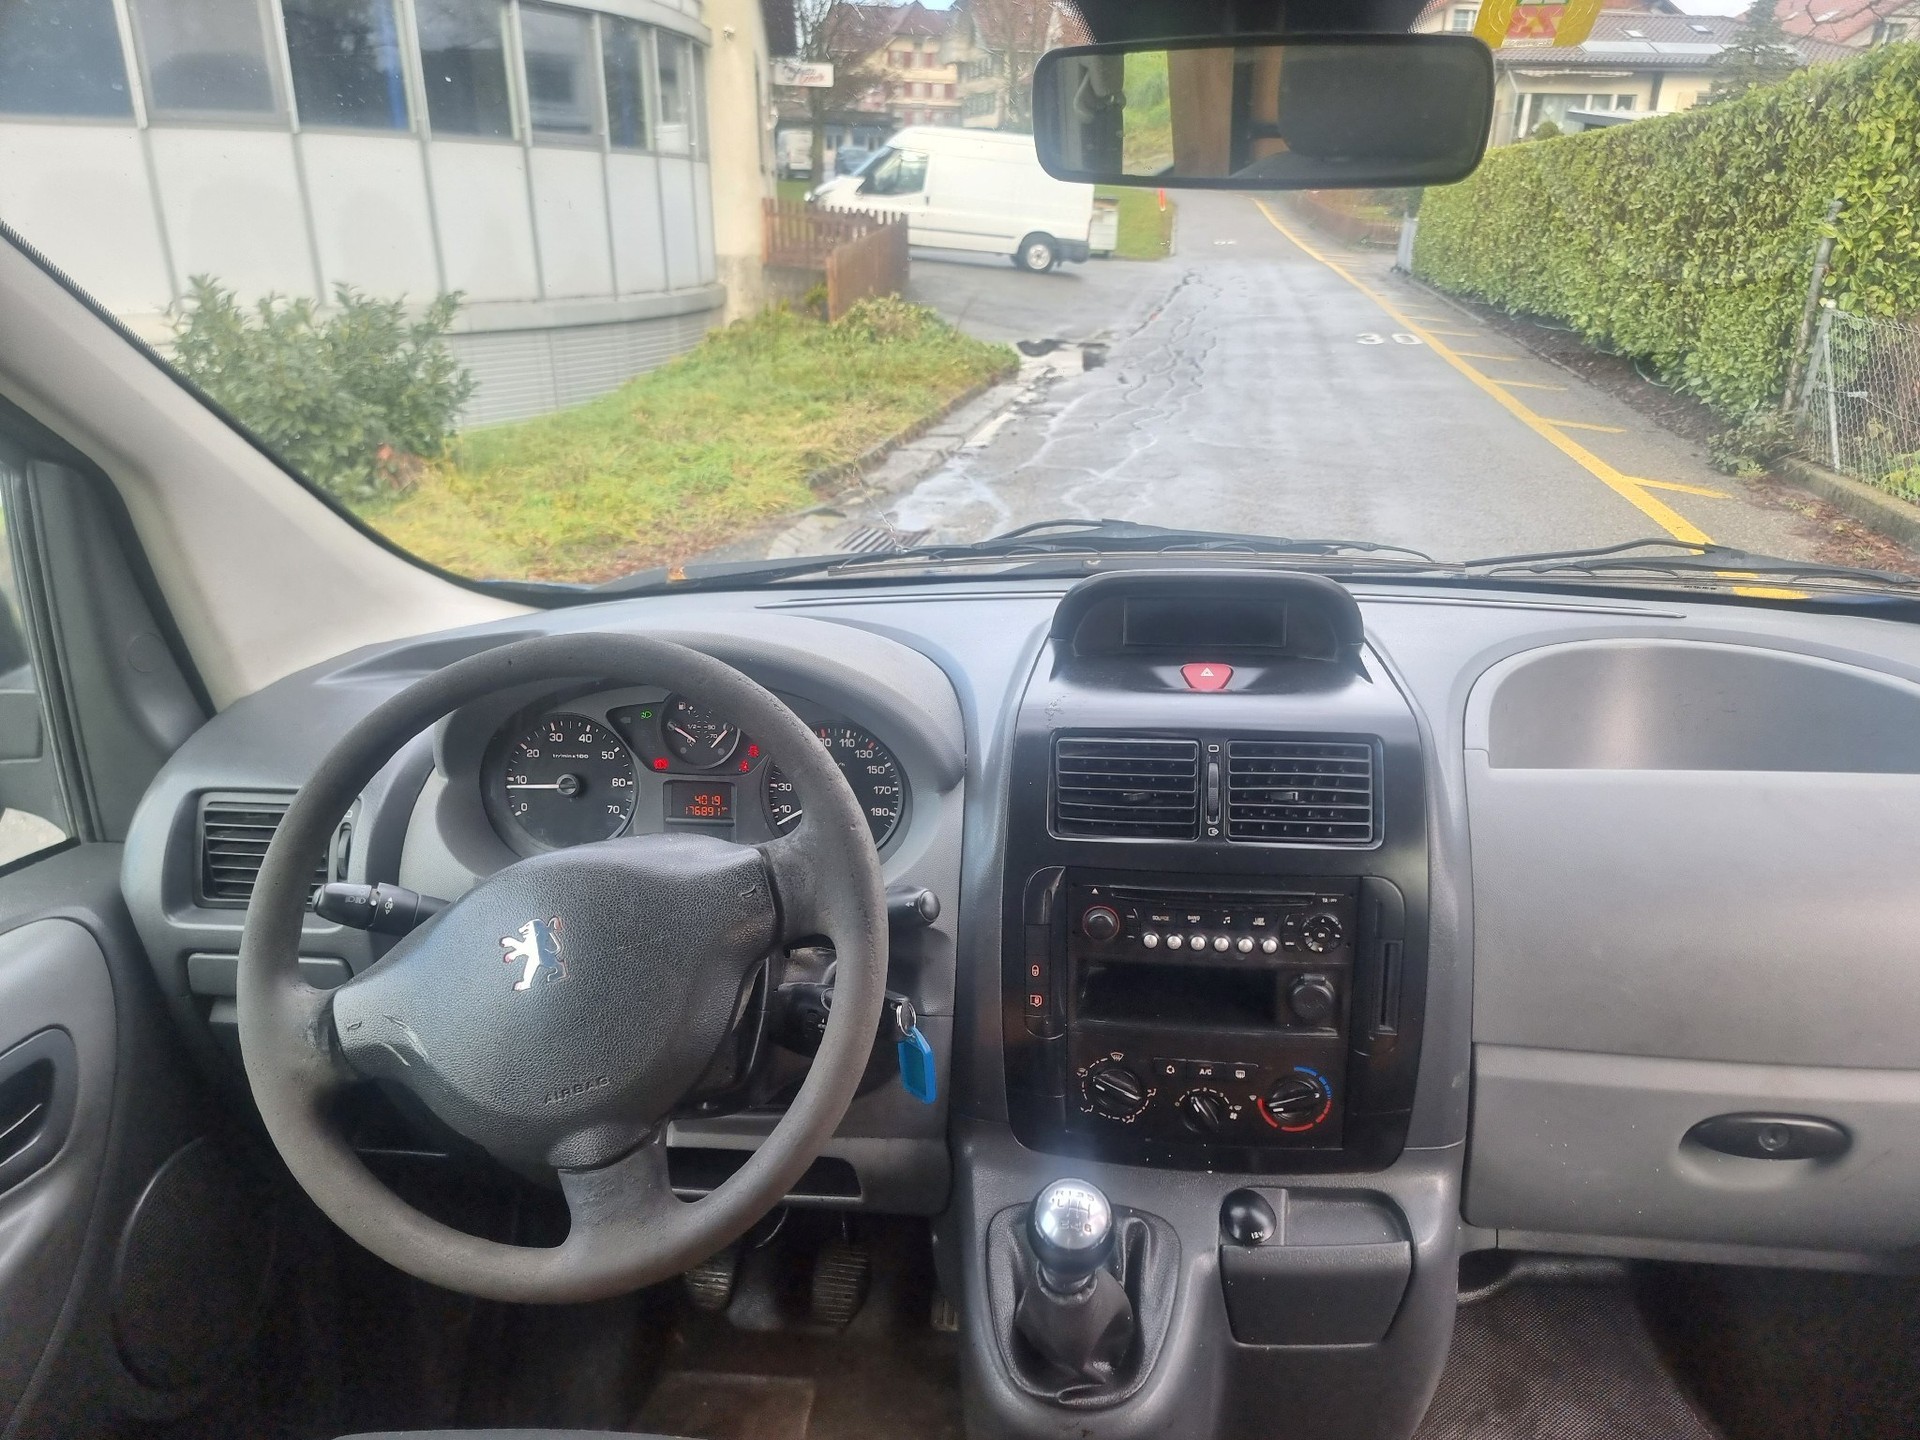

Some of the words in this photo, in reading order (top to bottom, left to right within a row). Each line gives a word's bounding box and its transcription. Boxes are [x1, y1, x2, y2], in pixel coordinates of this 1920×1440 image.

[1356, 332, 1423, 345] 30
[548, 732, 564, 743] 30
[578, 733, 593, 744] 40
[838, 739, 856, 748] 110
[526, 748, 540, 758] 20
[601, 750, 615, 760] 50
[854, 750, 873, 759] 130
[866, 766, 885, 775] 150
[514, 774, 528, 784] 10
[611, 778, 626, 788] 60
[778, 782, 792, 792] 30
[873, 786, 892, 795] 170
[520, 803, 528, 812] 0
[607, 805, 620, 815] 70
[685, 806, 720, 816] 176891
[780, 804, 792, 814] 10
[870, 807, 890, 816] 190
[544, 1077, 610, 1106] AIRBAG
